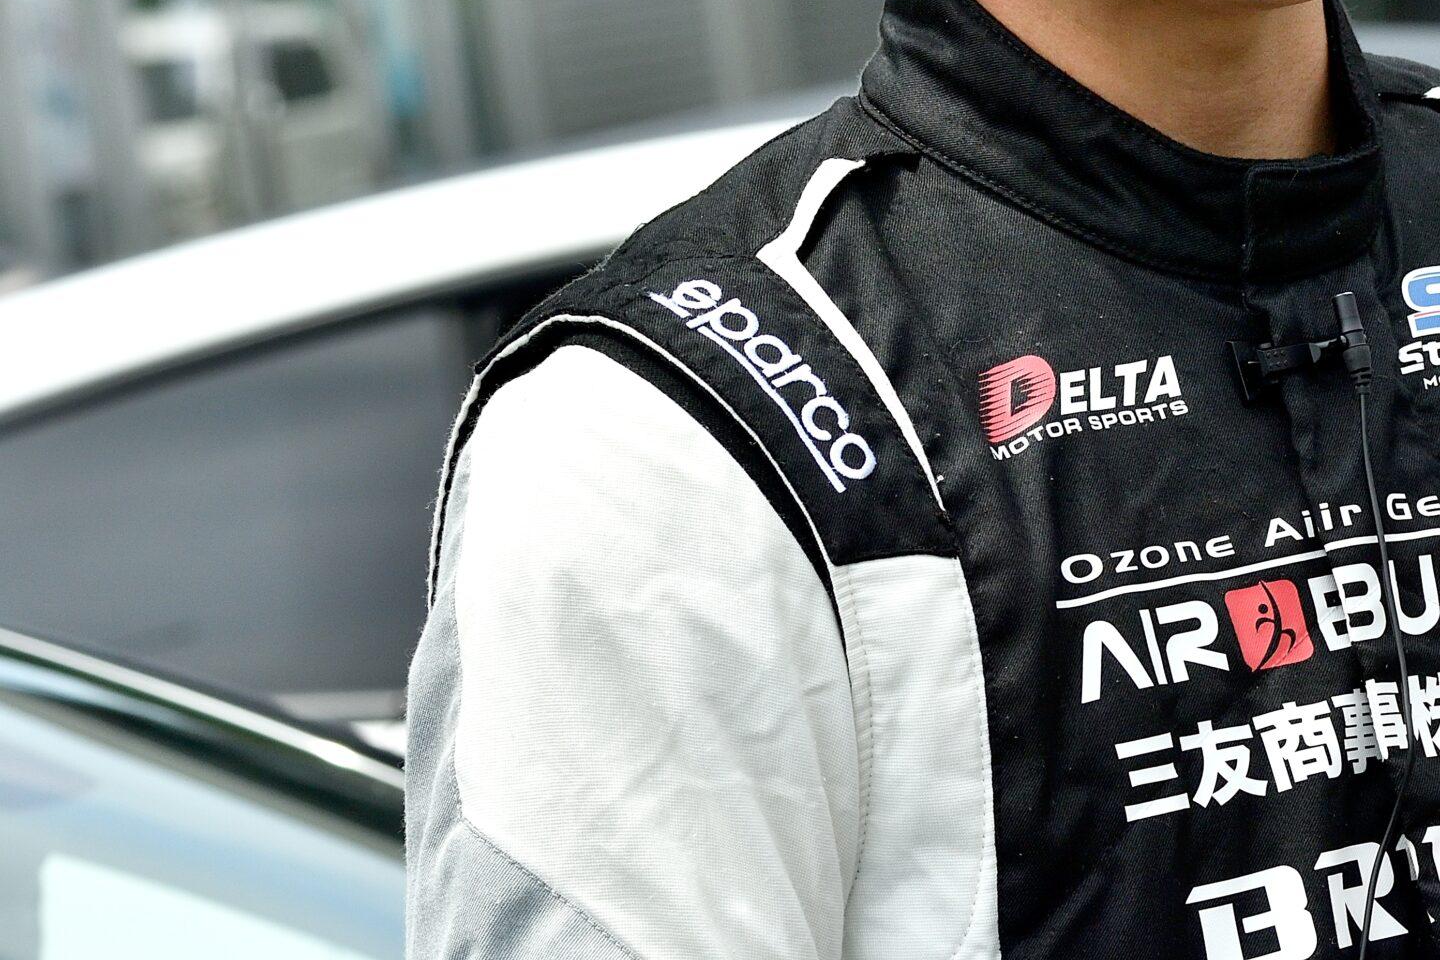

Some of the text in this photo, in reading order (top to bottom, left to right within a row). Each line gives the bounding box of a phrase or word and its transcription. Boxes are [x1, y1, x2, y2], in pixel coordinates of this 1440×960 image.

[648, 279, 878, 494] sparco
[978, 354, 1182, 443] DELTA
[989, 399, 1190, 461] MOTOR SPORTS
[1060, 534, 1235, 586] Ozone
[1081, 600, 1230, 704] AIR
